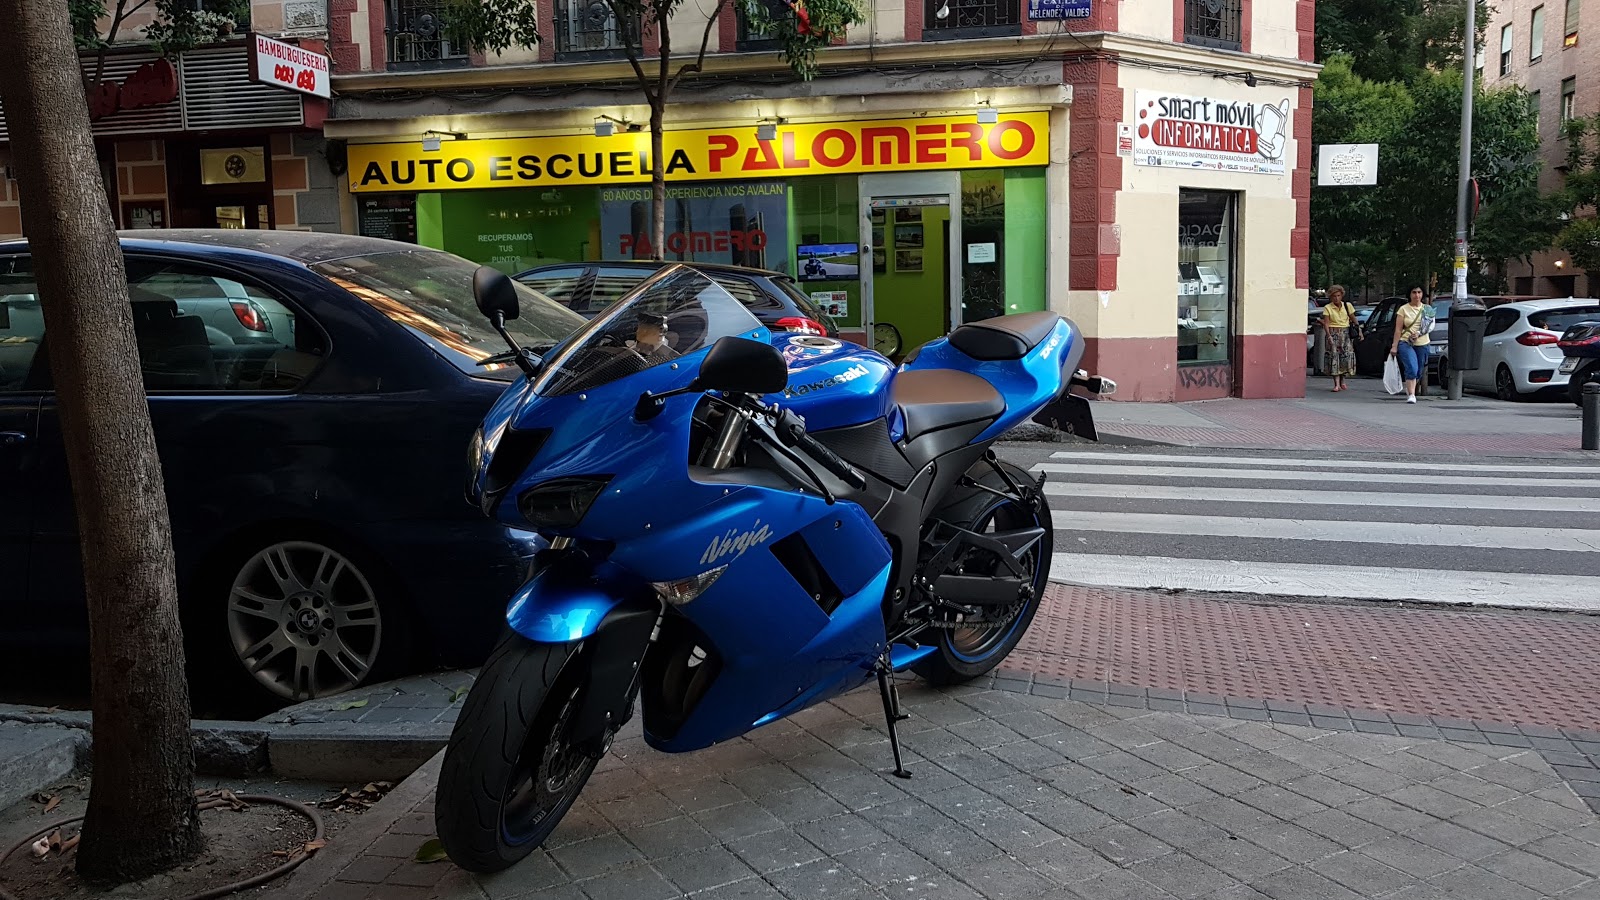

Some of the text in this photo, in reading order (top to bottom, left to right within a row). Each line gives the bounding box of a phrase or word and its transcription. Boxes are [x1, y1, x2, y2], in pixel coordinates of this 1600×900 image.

[257, 38, 328, 73] HAMBURGUESERIA
[1158, 96, 1254, 128] smart móvil
[1159, 119, 1251, 152] INFORMATICA
[361, 120, 1036, 186] AUTO ESCUELA PALOMERO
[603, 191, 615, 201] 60
[615, 188, 643, 201] AÑOS
[663, 186, 724, 199] XPERIENCIA
[724, 185, 746, 197] NOS
[747, 184, 783, 196] AVALAN
[478, 232, 534, 242] RECUPERAMOS
[498, 244, 514, 253] TUS
[619, 229, 767, 255] PAOMERO
[491, 255, 521, 264] PUNTOS
[784, 363, 870, 399] Kawasaki
[699, 518, 774, 565] Ninja
